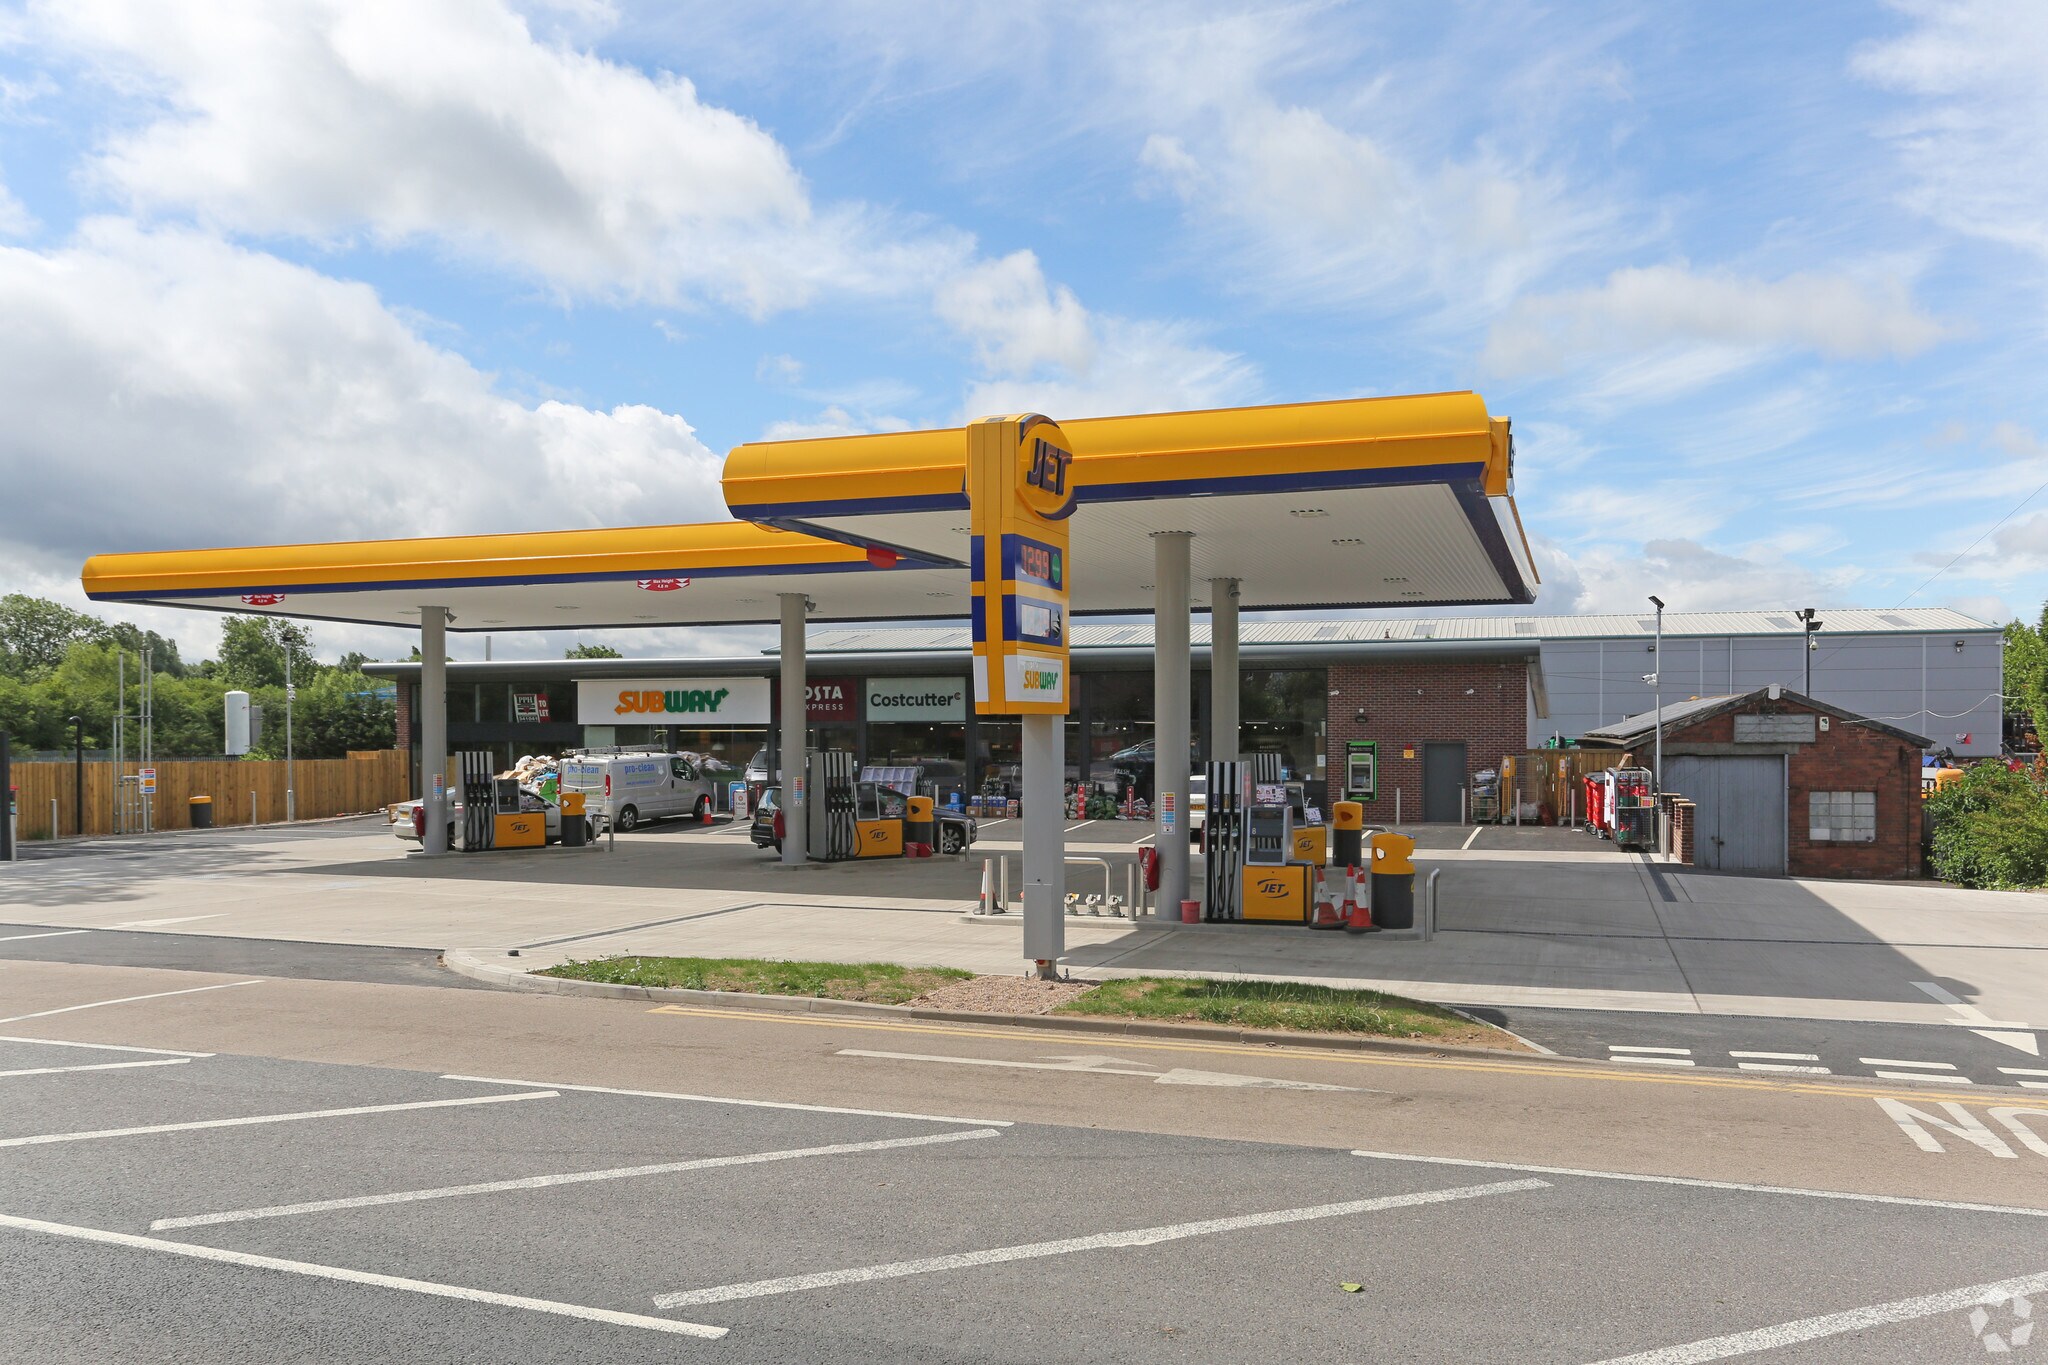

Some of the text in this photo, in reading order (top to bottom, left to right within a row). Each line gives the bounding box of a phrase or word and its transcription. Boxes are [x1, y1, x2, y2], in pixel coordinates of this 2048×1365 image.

[1026, 437, 1073, 496] JET
[1023, 669, 1058, 690] SUBWAY
[805, 685, 843, 701] OSTA
[518, 696, 533, 704] PPH
[538, 700, 547, 708] TO
[614, 688, 729, 715] SUBWAY
[870, 692, 954, 708] Costcutter
[805, 703, 843, 711] XPRESS
[539, 709, 549, 717] LET
[567, 764, 599, 775] pro-clean
[624, 763, 655, 775] pro-clean
[871, 831, 886, 839] JET
[1298, 839, 1312, 849] JET
[1261, 883, 1286, 894] JET
